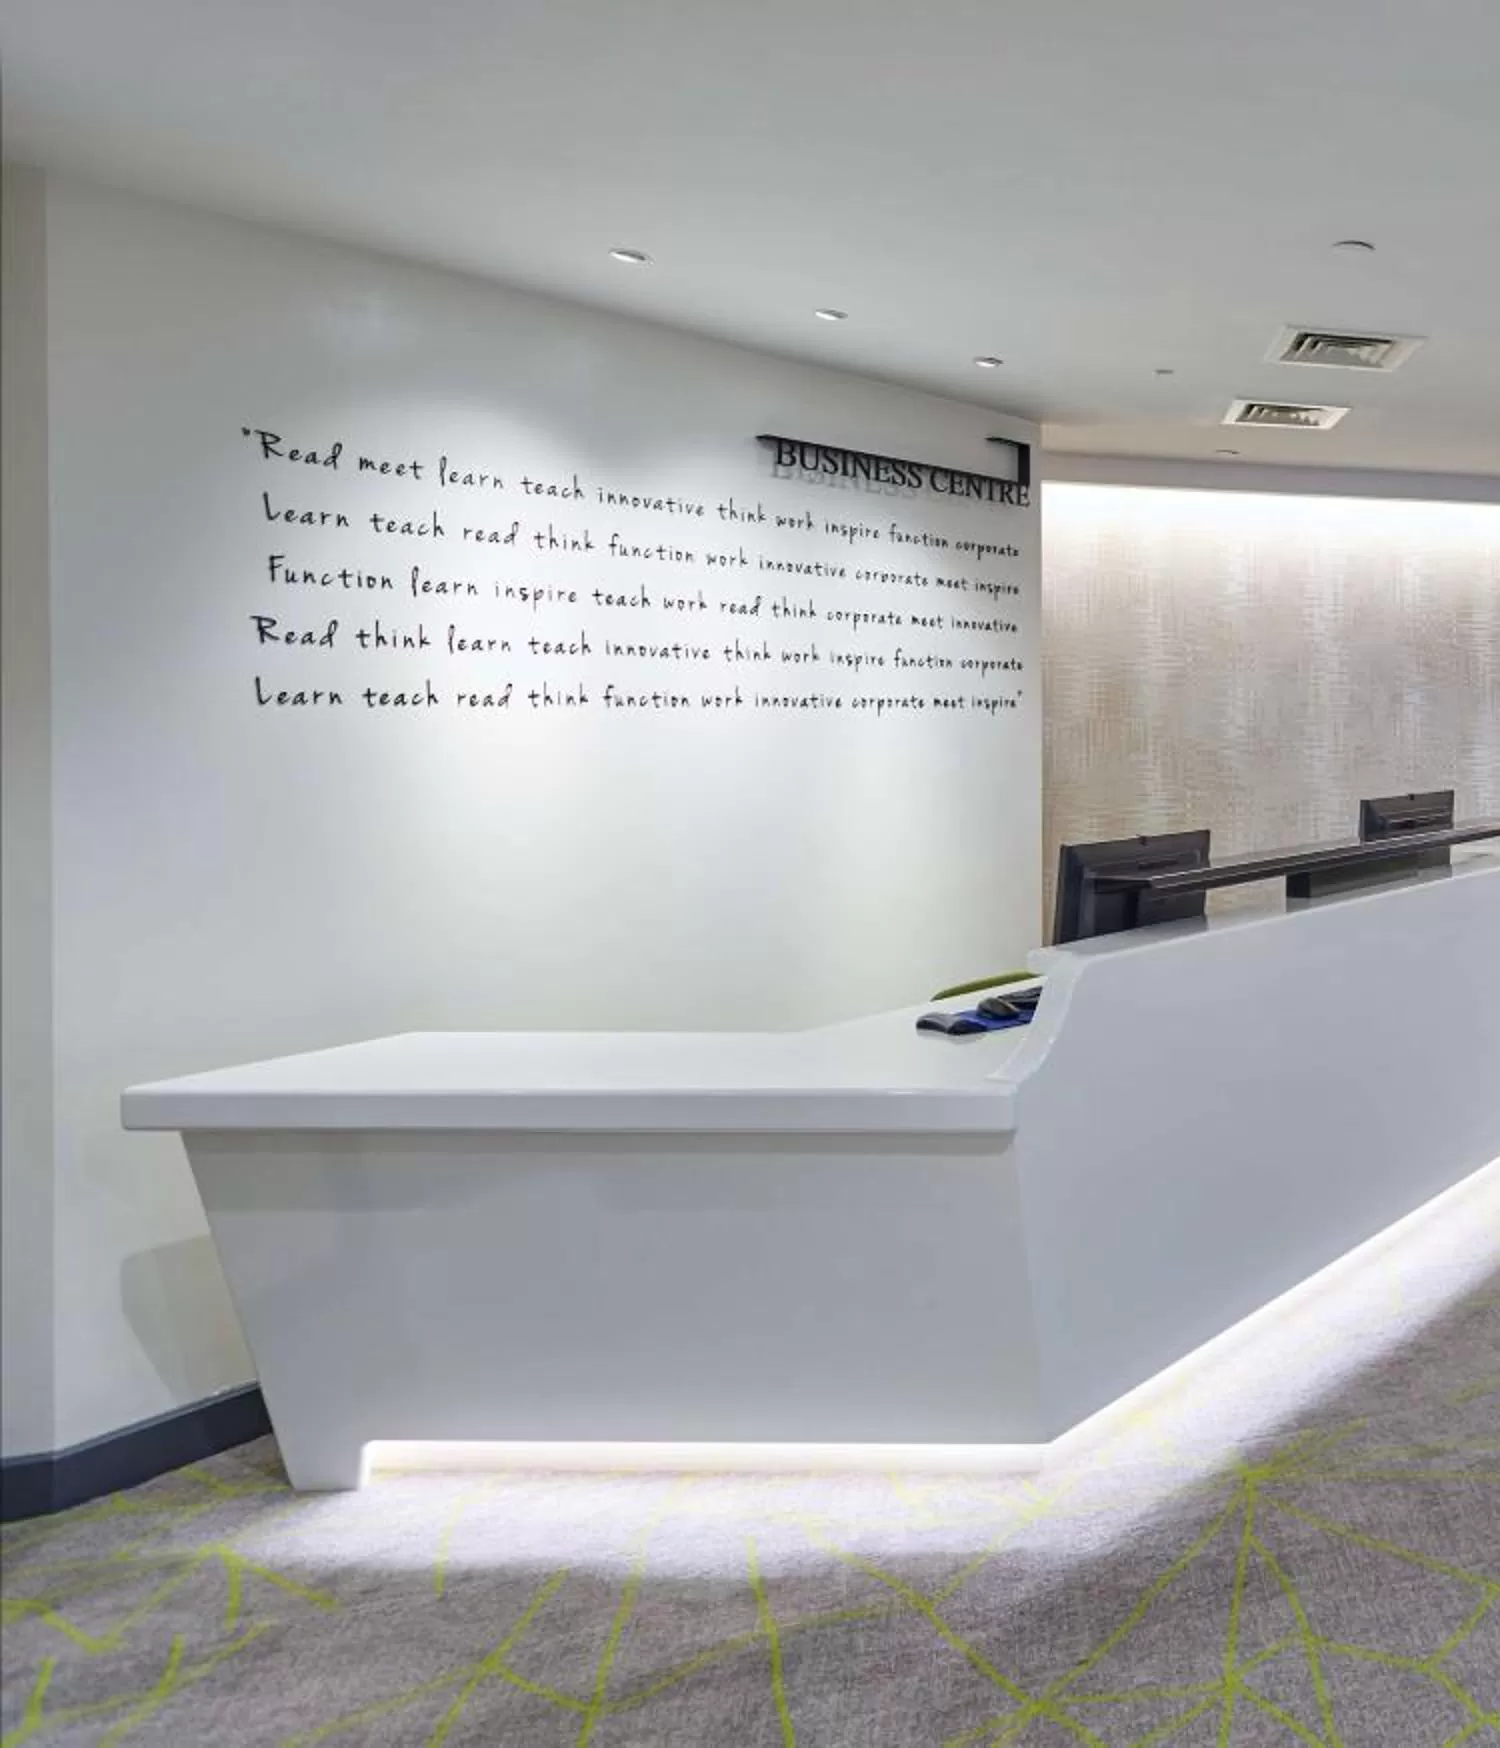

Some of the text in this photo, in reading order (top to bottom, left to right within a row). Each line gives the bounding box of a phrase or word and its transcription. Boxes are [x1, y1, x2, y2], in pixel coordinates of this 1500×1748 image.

[359, 456, 424, 480] meet
[439, 456, 504, 488] learn
[520, 474, 585, 500] teach
[598, 488, 704, 517] innovative
[717, 497, 766, 523] think
[776, 512, 814, 530] work
[825, 522, 879, 544] inspire
[889, 523, 948, 548] function
[956, 542, 1019, 560] corporate
[776, 439, 1031, 507] BUSINESS CENTRE
[262, 492, 1019, 601] Learn teach read think function work innovative corporate meet inspire
[268, 555, 1017, 632] Function learn inspire teach work read think corporate meet innovative
[250, 616, 1023, 678] Read think learn teach innovative think work inspire function corporate
[254, 676, 343, 706] Learn
[362, 678, 439, 708] teach
[457, 683, 513, 708] read
[528, 681, 588, 709] think
[602, 684, 690, 708] function
[701, 686, 743, 708] work
[755, 694, 842, 709] innovative
[852, 695, 925, 716] corporate
[933, 696, 965, 709] meet
